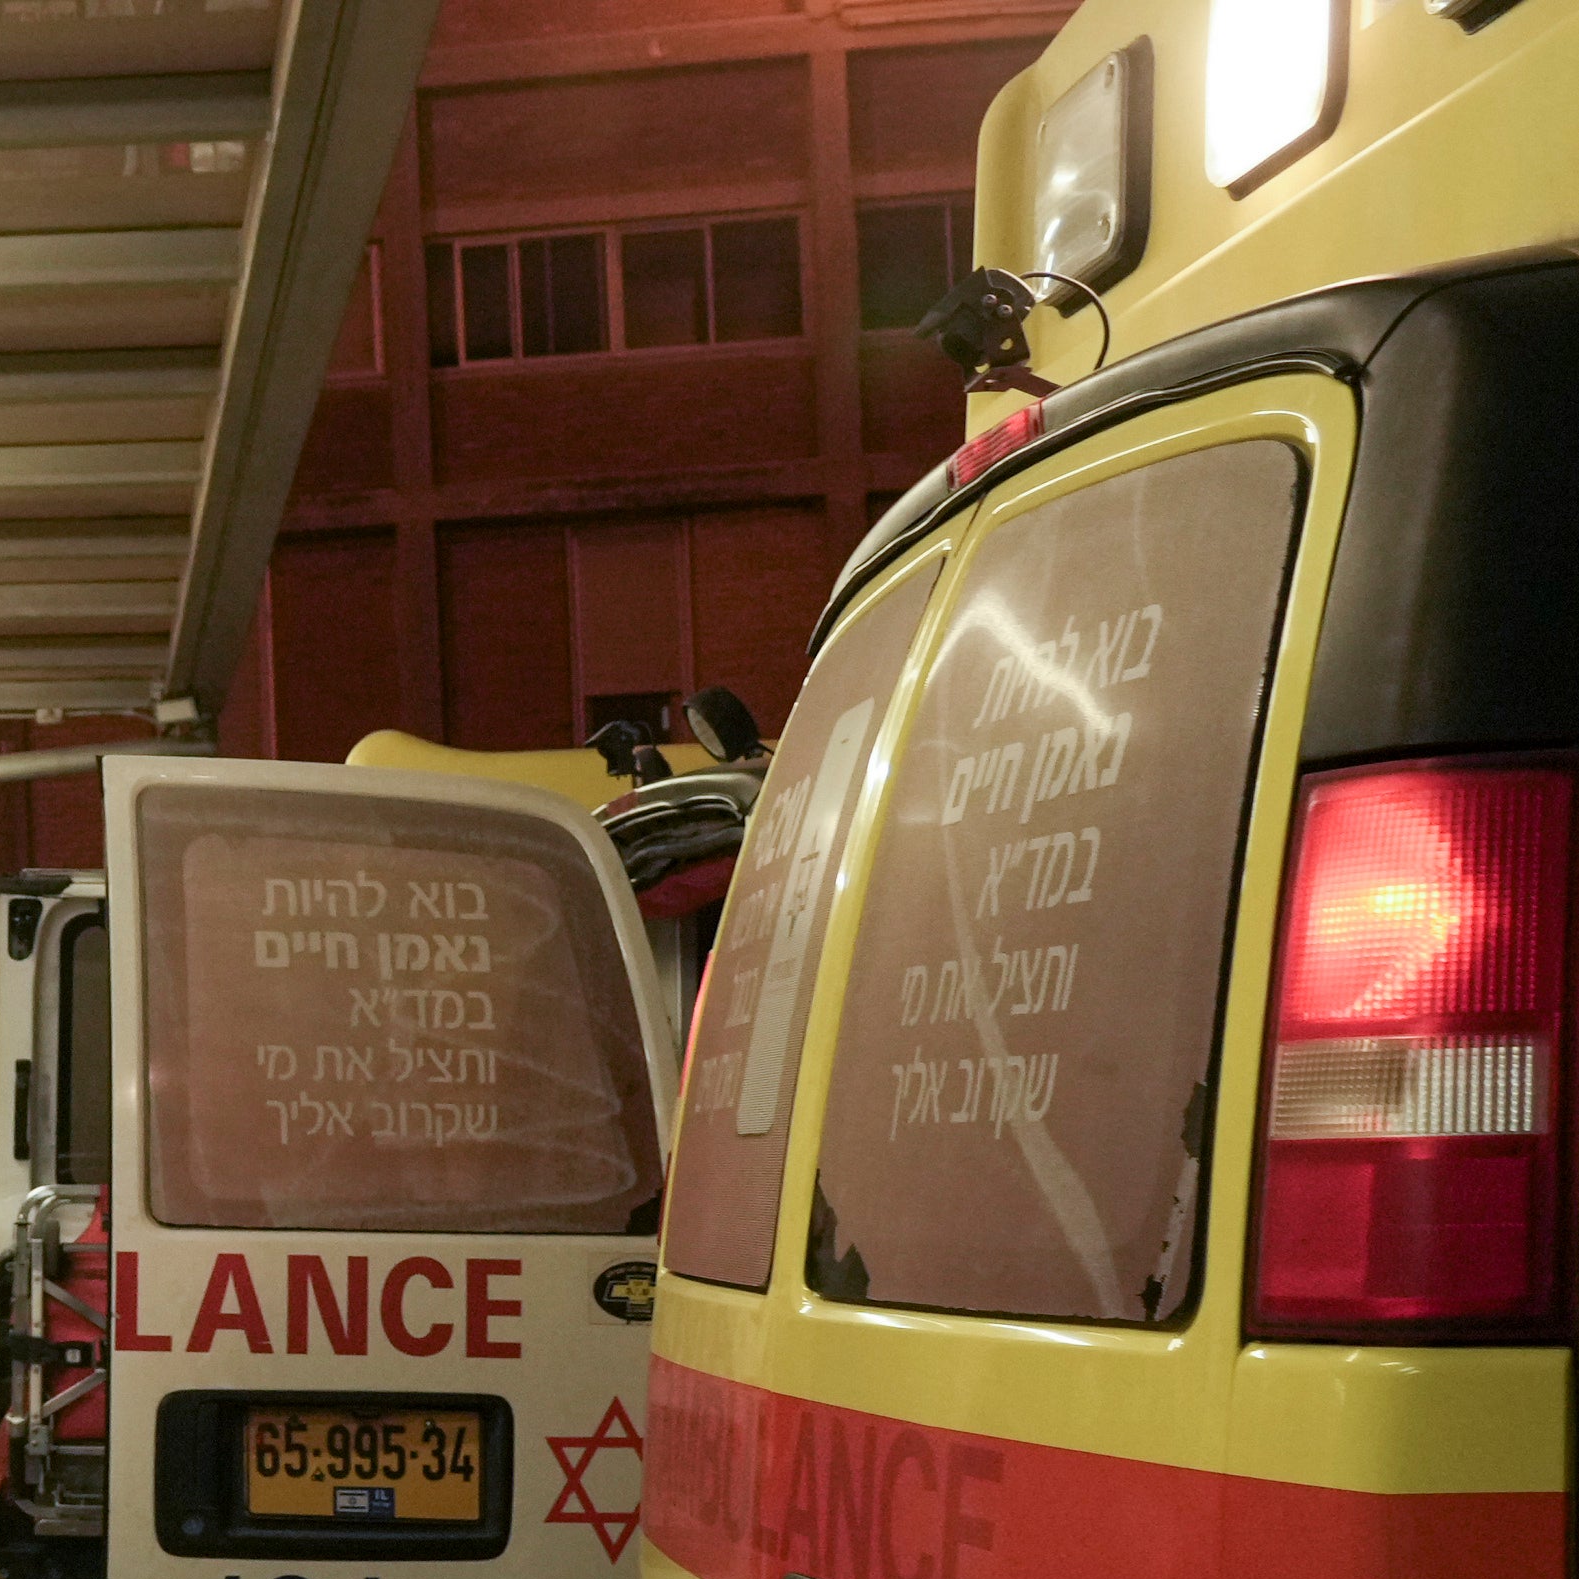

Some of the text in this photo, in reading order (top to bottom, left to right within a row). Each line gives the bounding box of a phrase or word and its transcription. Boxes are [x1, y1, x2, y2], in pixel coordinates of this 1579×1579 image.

[1085, 604, 1162, 688] בוא
[942, 712, 1132, 826] נאמן חיים
[262, 870, 489, 920] בוא להיות
[254, 930, 491, 981] נאמן חיים
[988, 935, 1079, 1016] ותציל
[258, 1038, 496, 1084] ותציל את מי
[890, 1045, 947, 1141] אליך
[266, 1091, 497, 1148] שקרוב אליך
[113, 1251, 523, 1359] LANCE
